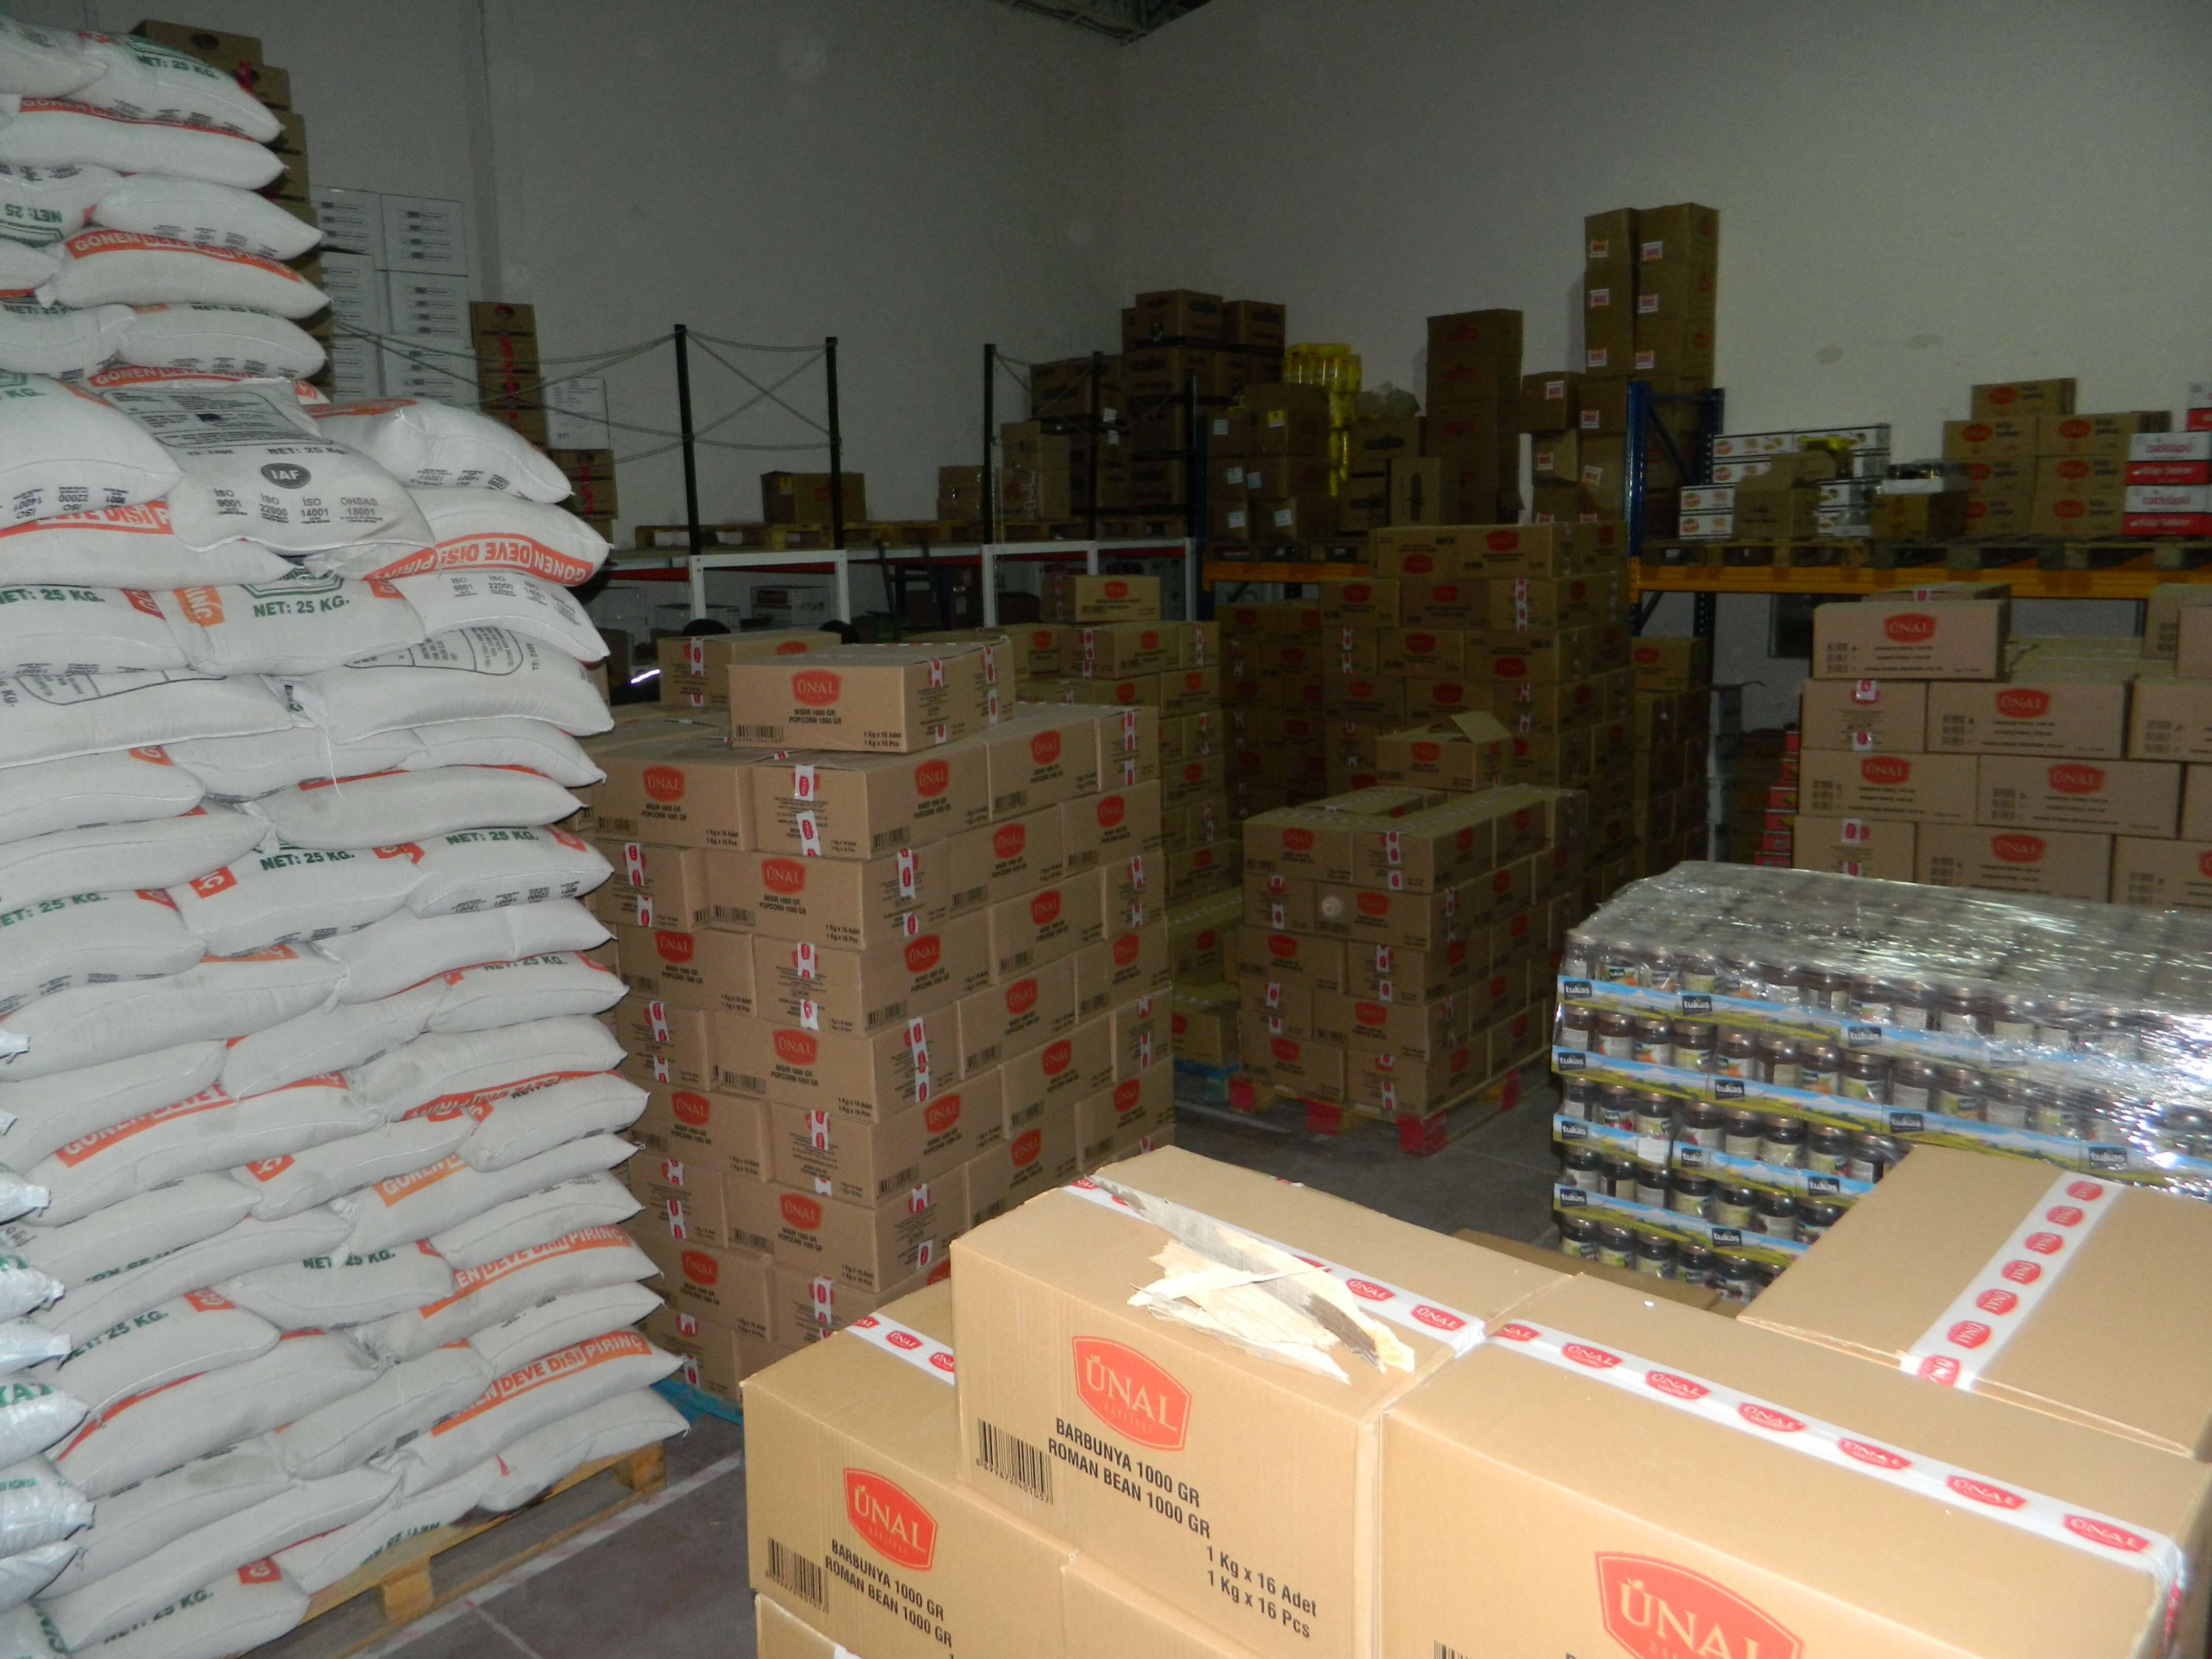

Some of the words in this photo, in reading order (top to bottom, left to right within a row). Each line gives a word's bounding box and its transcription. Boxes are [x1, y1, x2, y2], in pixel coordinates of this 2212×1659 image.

[271, 470, 300, 480] IAF
[217, 499, 242, 507] 9001
[260, 504, 288, 516] 22000
[301, 508, 328, 517] 14001
[348, 507, 375, 516] 18001
[341, 497, 377, 506] OHSAS
[485, 542, 530, 564] DEVE
[40, 589, 66, 601] 25
[70, 589, 105, 603] KG.
[253, 601, 291, 617] NET:
[296, 600, 314, 614] 25
[321, 596, 349, 612] KG.
[797, 678, 838, 694] ÜNAL
[647, 775, 680, 790] ÜNAL
[446, 832, 485, 845] NET:
[492, 831, 509, 841] 25
[514, 831, 539, 842] KG.
[260, 856, 301, 871] NET:
[307, 853, 325, 864] 25
[328, 850, 355, 861] KG.
[765, 866, 801, 884] ÜNAL
[0, 907, 33, 928] ET:
[39, 900, 66, 913] 25
[73, 892, 108, 906] KG.
[660, 934, 690, 953] ÜNAL
[778, 1036, 813, 1055] ÜNAL
[675, 1100, 706, 1116] ÜNAL
[785, 1199, 817, 1221] ÜNAL
[369, 1249, 396, 1263] KG.
[685, 1256, 716, 1277] ÜNAL
[1349, 1281, 1387, 1300] ÜNAL
[134, 1310, 169, 1328] KG.
[1417, 1307, 1457, 1329] ÜNAL
[890, 1331, 917, 1349] ÜNAL
[1567, 1344, 1614, 1365] ÜNAL
[502, 1364, 546, 1392] DEVE
[1651, 1372, 1701, 1396] ÜNAL
[1085, 1353, 1177, 1432] ÜNAL
[1743, 1405, 1794, 1429] ÜNAL
[1056, 1417, 1132, 1472] BARBUNYA
[1136, 1461, 1173, 1493] 1000
[1178, 1481, 1200, 1508] GR
[1049, 1438, 1098, 1479] ROMAN
[1103, 1466, 1141, 1502] BEAN
[1146, 1491, 1183, 1524] 1000
[1188, 1513, 1210, 1538] GR
[1952, 1478, 2016, 1506] ÜNAL
[854, 1484, 926, 1554] ÜNAL
[2071, 1518, 2140, 1547] ÜNAL
[832, 1538, 890, 1588] BARBUNYA
[896, 1580, 923, 1607] 1000
[927, 1599, 944, 1621] GR
[1206, 1545, 1214, 1562] 1
[1220, 1550, 1239, 1578] Kg
[1243, 1567, 1251, 1582] x
[1258, 1572, 1275, 1594] 16
[1282, 1584, 1317, 1617] Adet
[181, 1589, 214, 1608] KG.
[825, 1556, 864, 1593] ROMAN
[868, 1583, 898, 1614] BEAN
[902, 1606, 931, 1634] 1000
[935, 1626, 952, 1648] GR
[1207, 1570, 1214, 1586] 1
[1221, 1575, 1240, 1603] Kg
[1244, 1591, 1252, 1607] x
[1259, 1597, 1277, 1619] 16
[1283, 1609, 1310, 1638] Pcs
